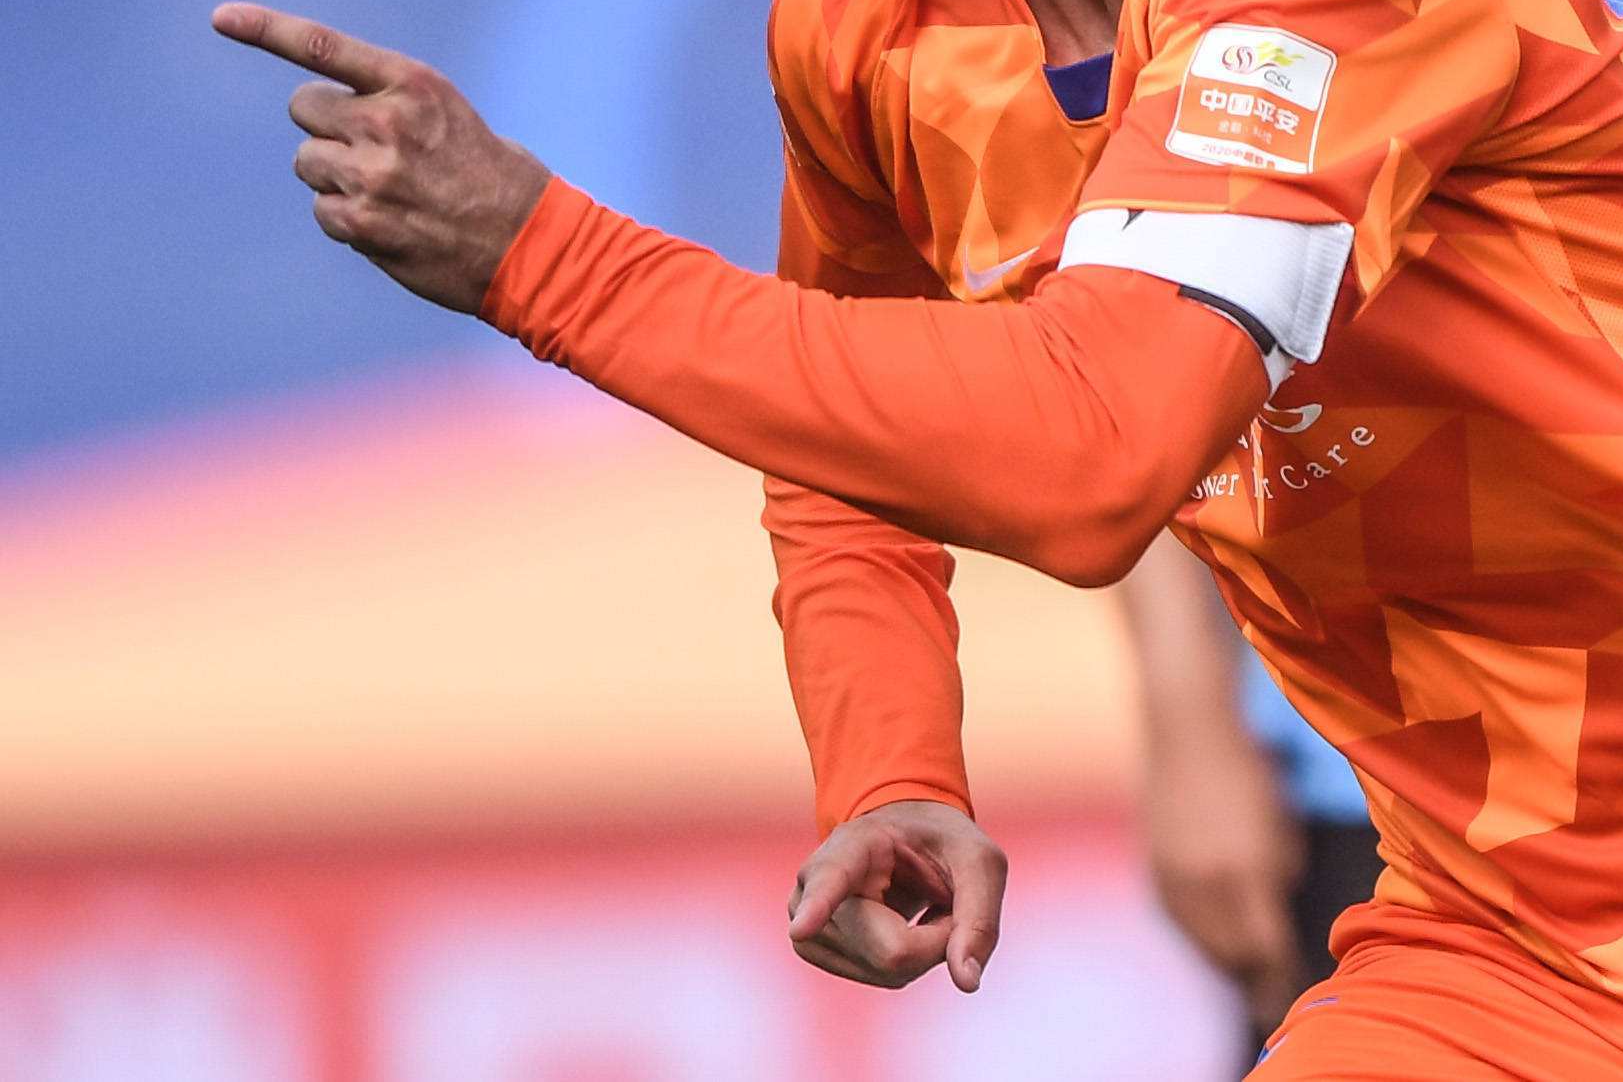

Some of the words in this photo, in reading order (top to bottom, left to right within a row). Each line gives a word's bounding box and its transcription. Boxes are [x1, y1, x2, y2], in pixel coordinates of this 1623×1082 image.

[1263, 69, 1294, 92] CSL
[1199, 88, 1301, 135] 中国平安
[1279, 425, 1376, 490] Care
